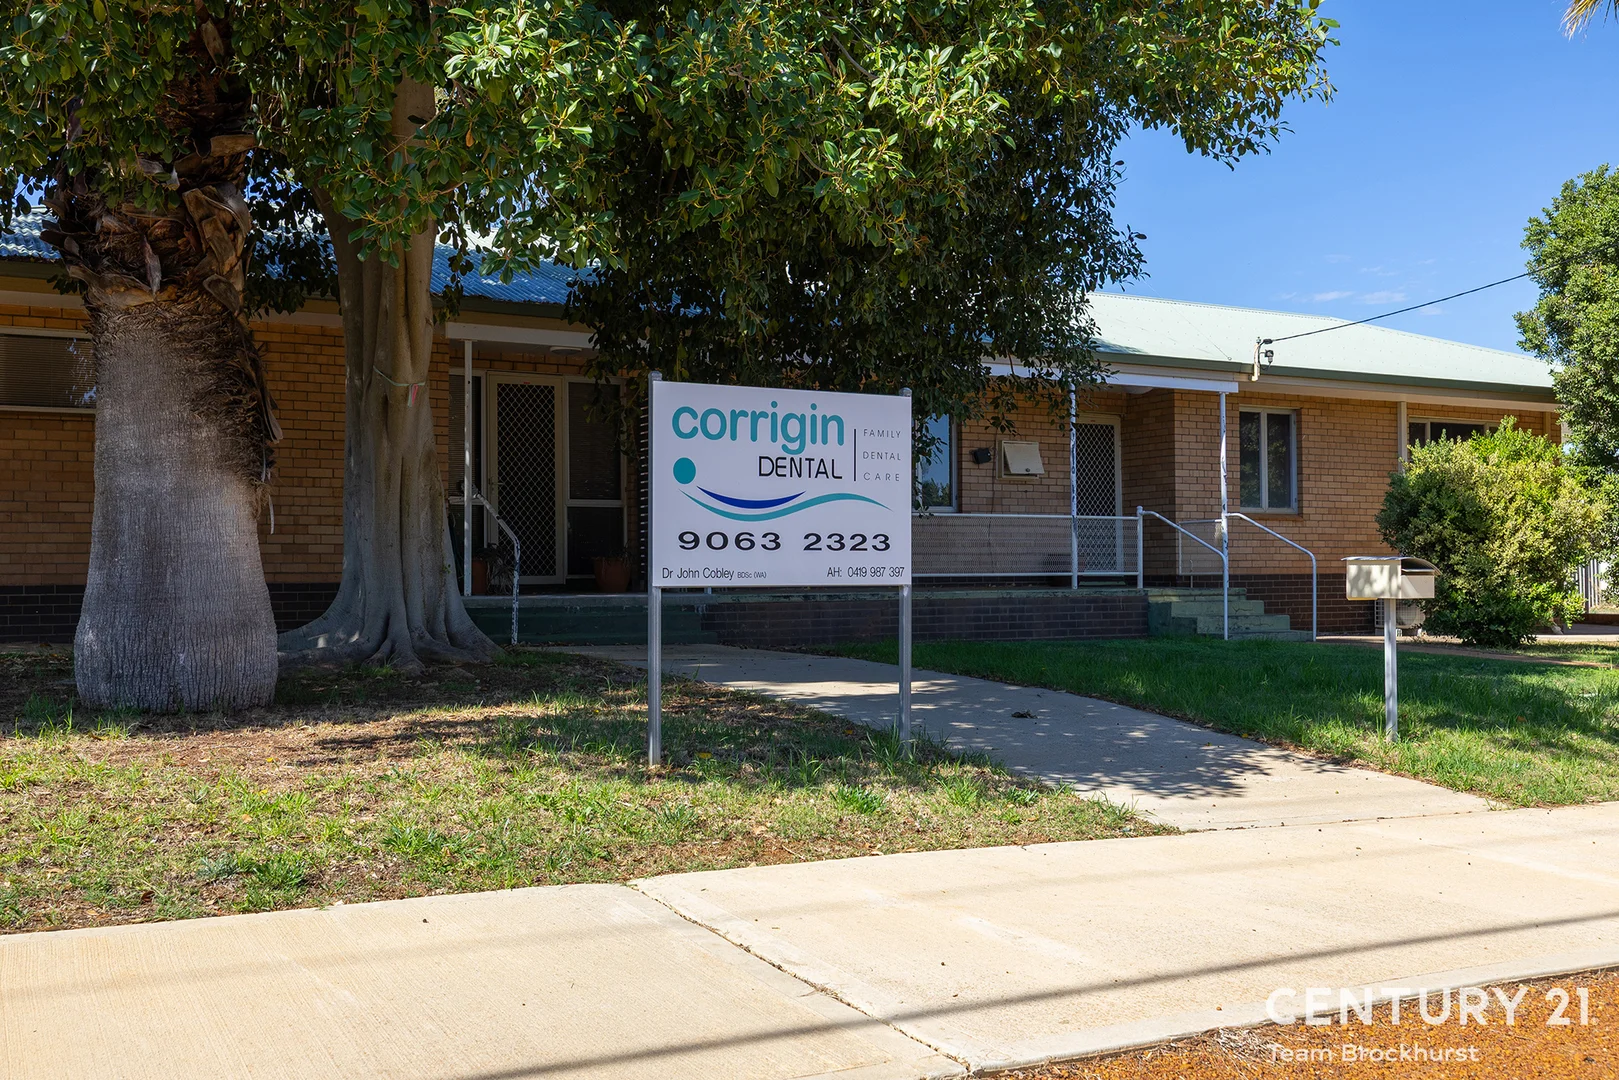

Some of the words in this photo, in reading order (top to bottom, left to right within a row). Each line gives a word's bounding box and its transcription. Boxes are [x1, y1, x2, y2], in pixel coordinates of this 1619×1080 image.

[672, 400, 845, 455] corrigin
[863, 428, 902, 439] FAMILY
[862, 450, 902, 461] DENTAL
[758, 455, 843, 479] DENTAL
[863, 472, 901, 482] CARE
[678, 531, 782, 551] 9063
[803, 532, 891, 551] 2323
[662, 567, 673, 579] Dr
[676, 567, 700, 579] John
[702, 567, 734, 581] Cobley
[827, 567, 842, 577] AH:
[847, 566, 867, 577] 0419
[869, 566, 886, 577] 987
[888, 566, 905, 577] 397
